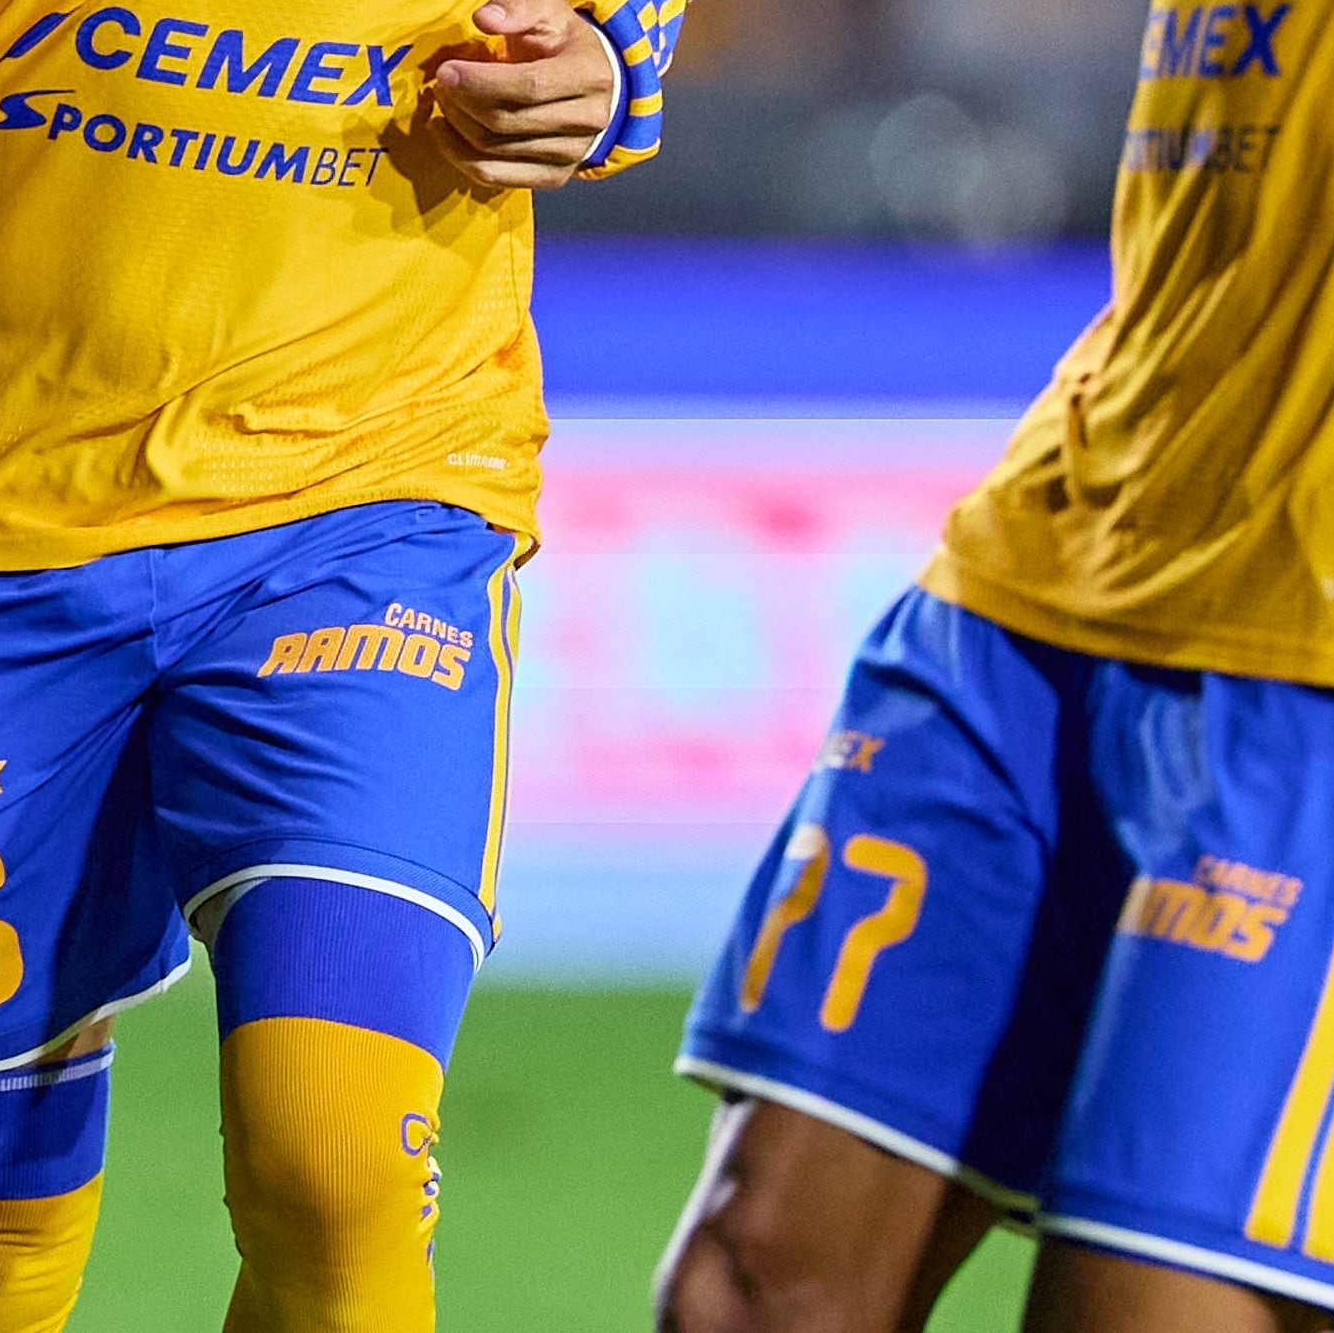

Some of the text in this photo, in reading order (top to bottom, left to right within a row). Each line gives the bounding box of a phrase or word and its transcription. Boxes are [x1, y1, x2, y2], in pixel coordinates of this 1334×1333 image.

[74, 6, 414, 107] CEMEX
[257, 623, 471, 692] RAMOS
[384, 602, 473, 649] CARNES
